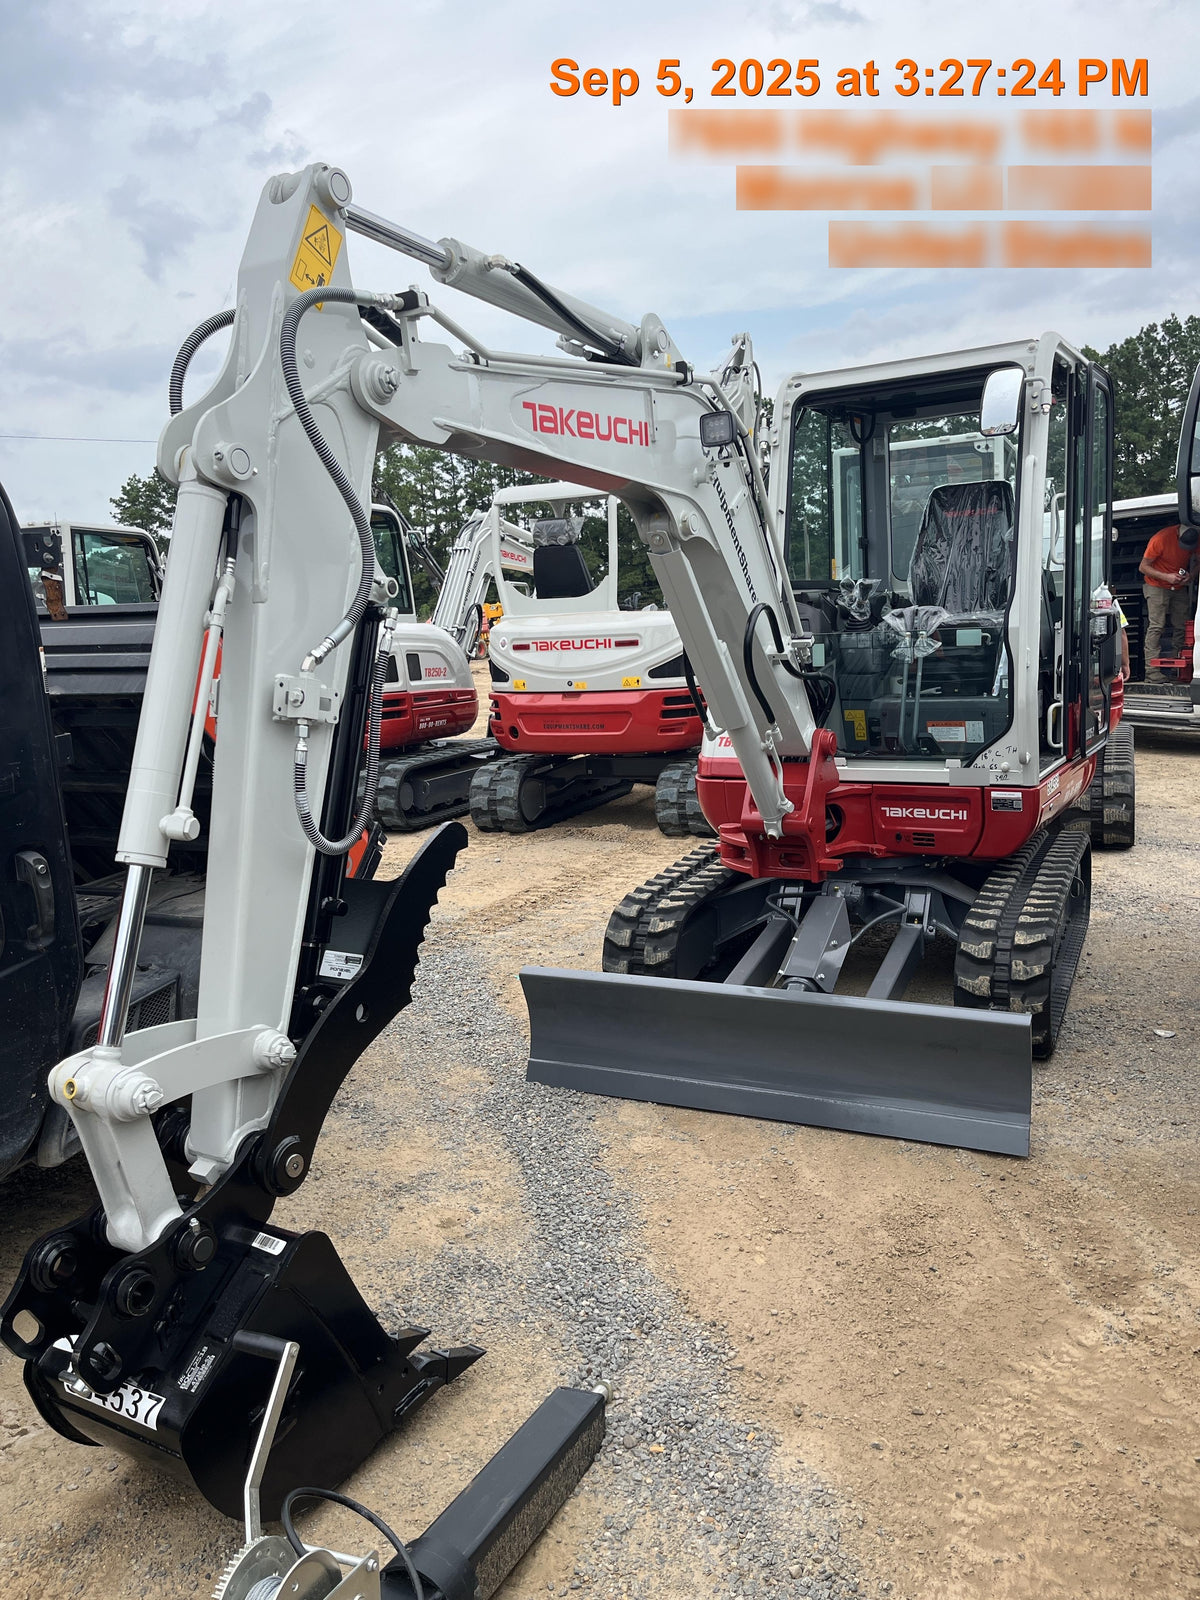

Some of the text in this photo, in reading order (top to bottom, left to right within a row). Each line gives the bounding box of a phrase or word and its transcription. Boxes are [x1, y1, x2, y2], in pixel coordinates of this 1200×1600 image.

[522, 401, 649, 447] TAKEUCHI
[500, 550, 527, 563] TAKEUCHI
[531, 638, 612, 652] TAKEUCHI
[424, 666, 448, 678] TB250-2
[718, 736, 734, 747] TB
[881, 806, 968, 820] TAKEUCHI
